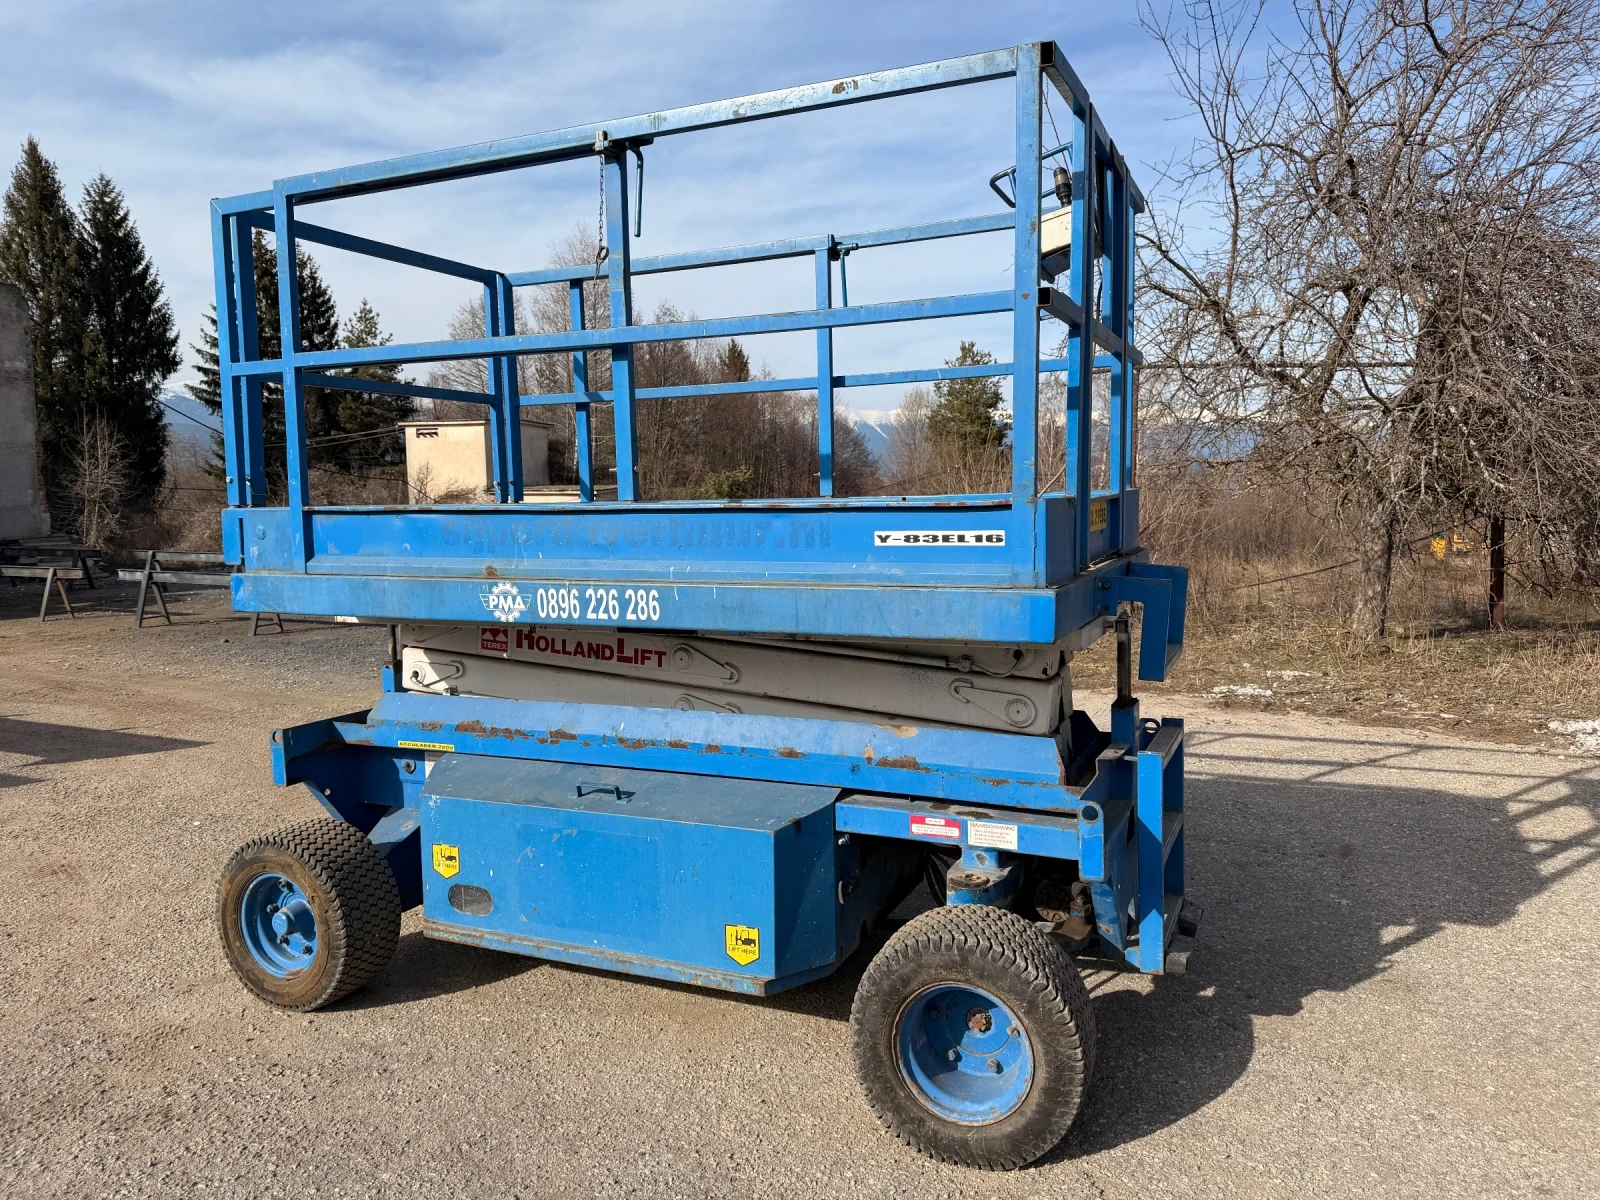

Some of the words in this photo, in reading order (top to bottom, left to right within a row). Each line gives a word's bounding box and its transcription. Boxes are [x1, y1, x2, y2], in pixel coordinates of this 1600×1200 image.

[876, 534, 1004, 543] Y-83EL16
[488, 595, 526, 614] PMA
[536, 588, 580, 619] 0896
[585, 588, 620, 620] 226
[625, 589, 660, 621] 286
[482, 640, 507, 650] TEREX
